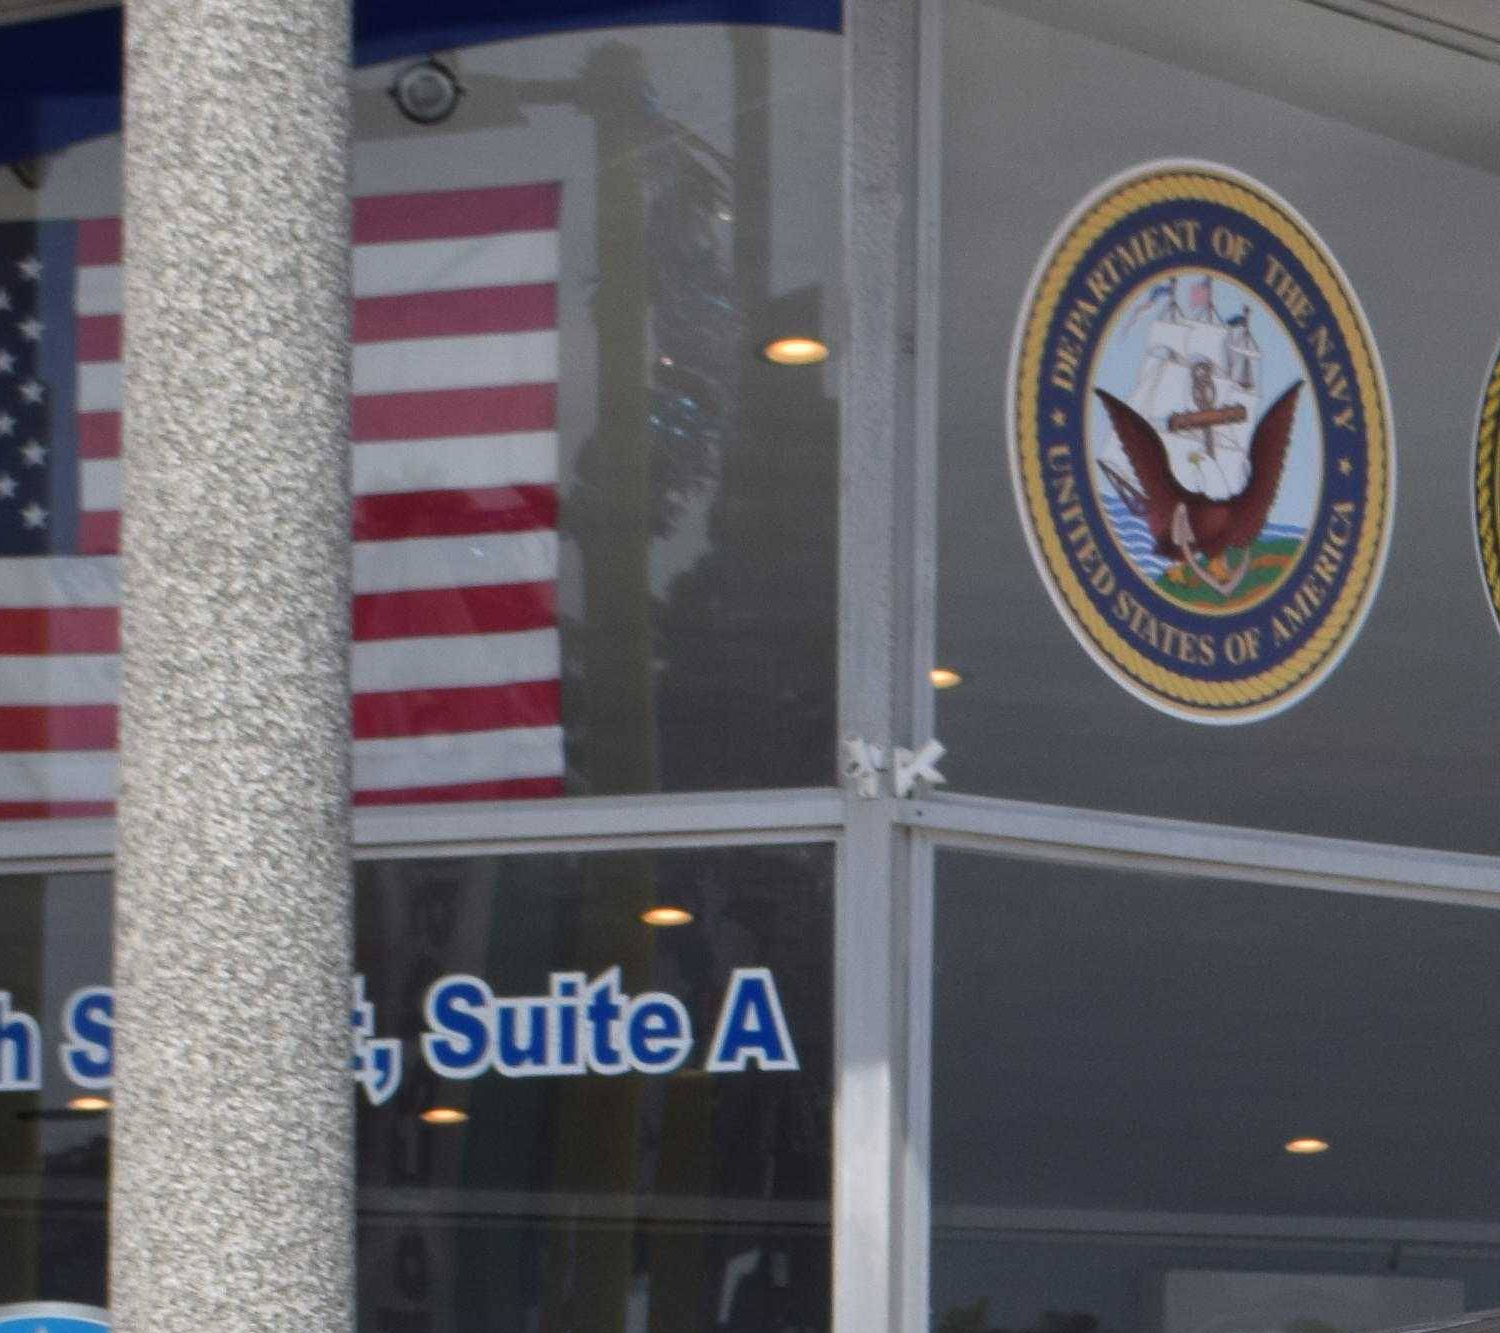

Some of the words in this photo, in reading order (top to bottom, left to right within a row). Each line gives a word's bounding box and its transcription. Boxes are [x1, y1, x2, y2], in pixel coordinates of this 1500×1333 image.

[1053, 217, 1202, 393] DEPARTMENT
[1211, 226, 1254, 266] OF
[1262, 252, 1318, 323] THE
[1311, 320, 1358, 435] NAVY
[1045, 443, 1116, 608] UNITED
[1112, 595, 1216, 669] STATES
[1225, 631, 1263, 669] OF
[1269, 500, 1355, 651] AMERICA
[420, 970, 694, 1082] Suite
[707, 968, 798, 1073] A
